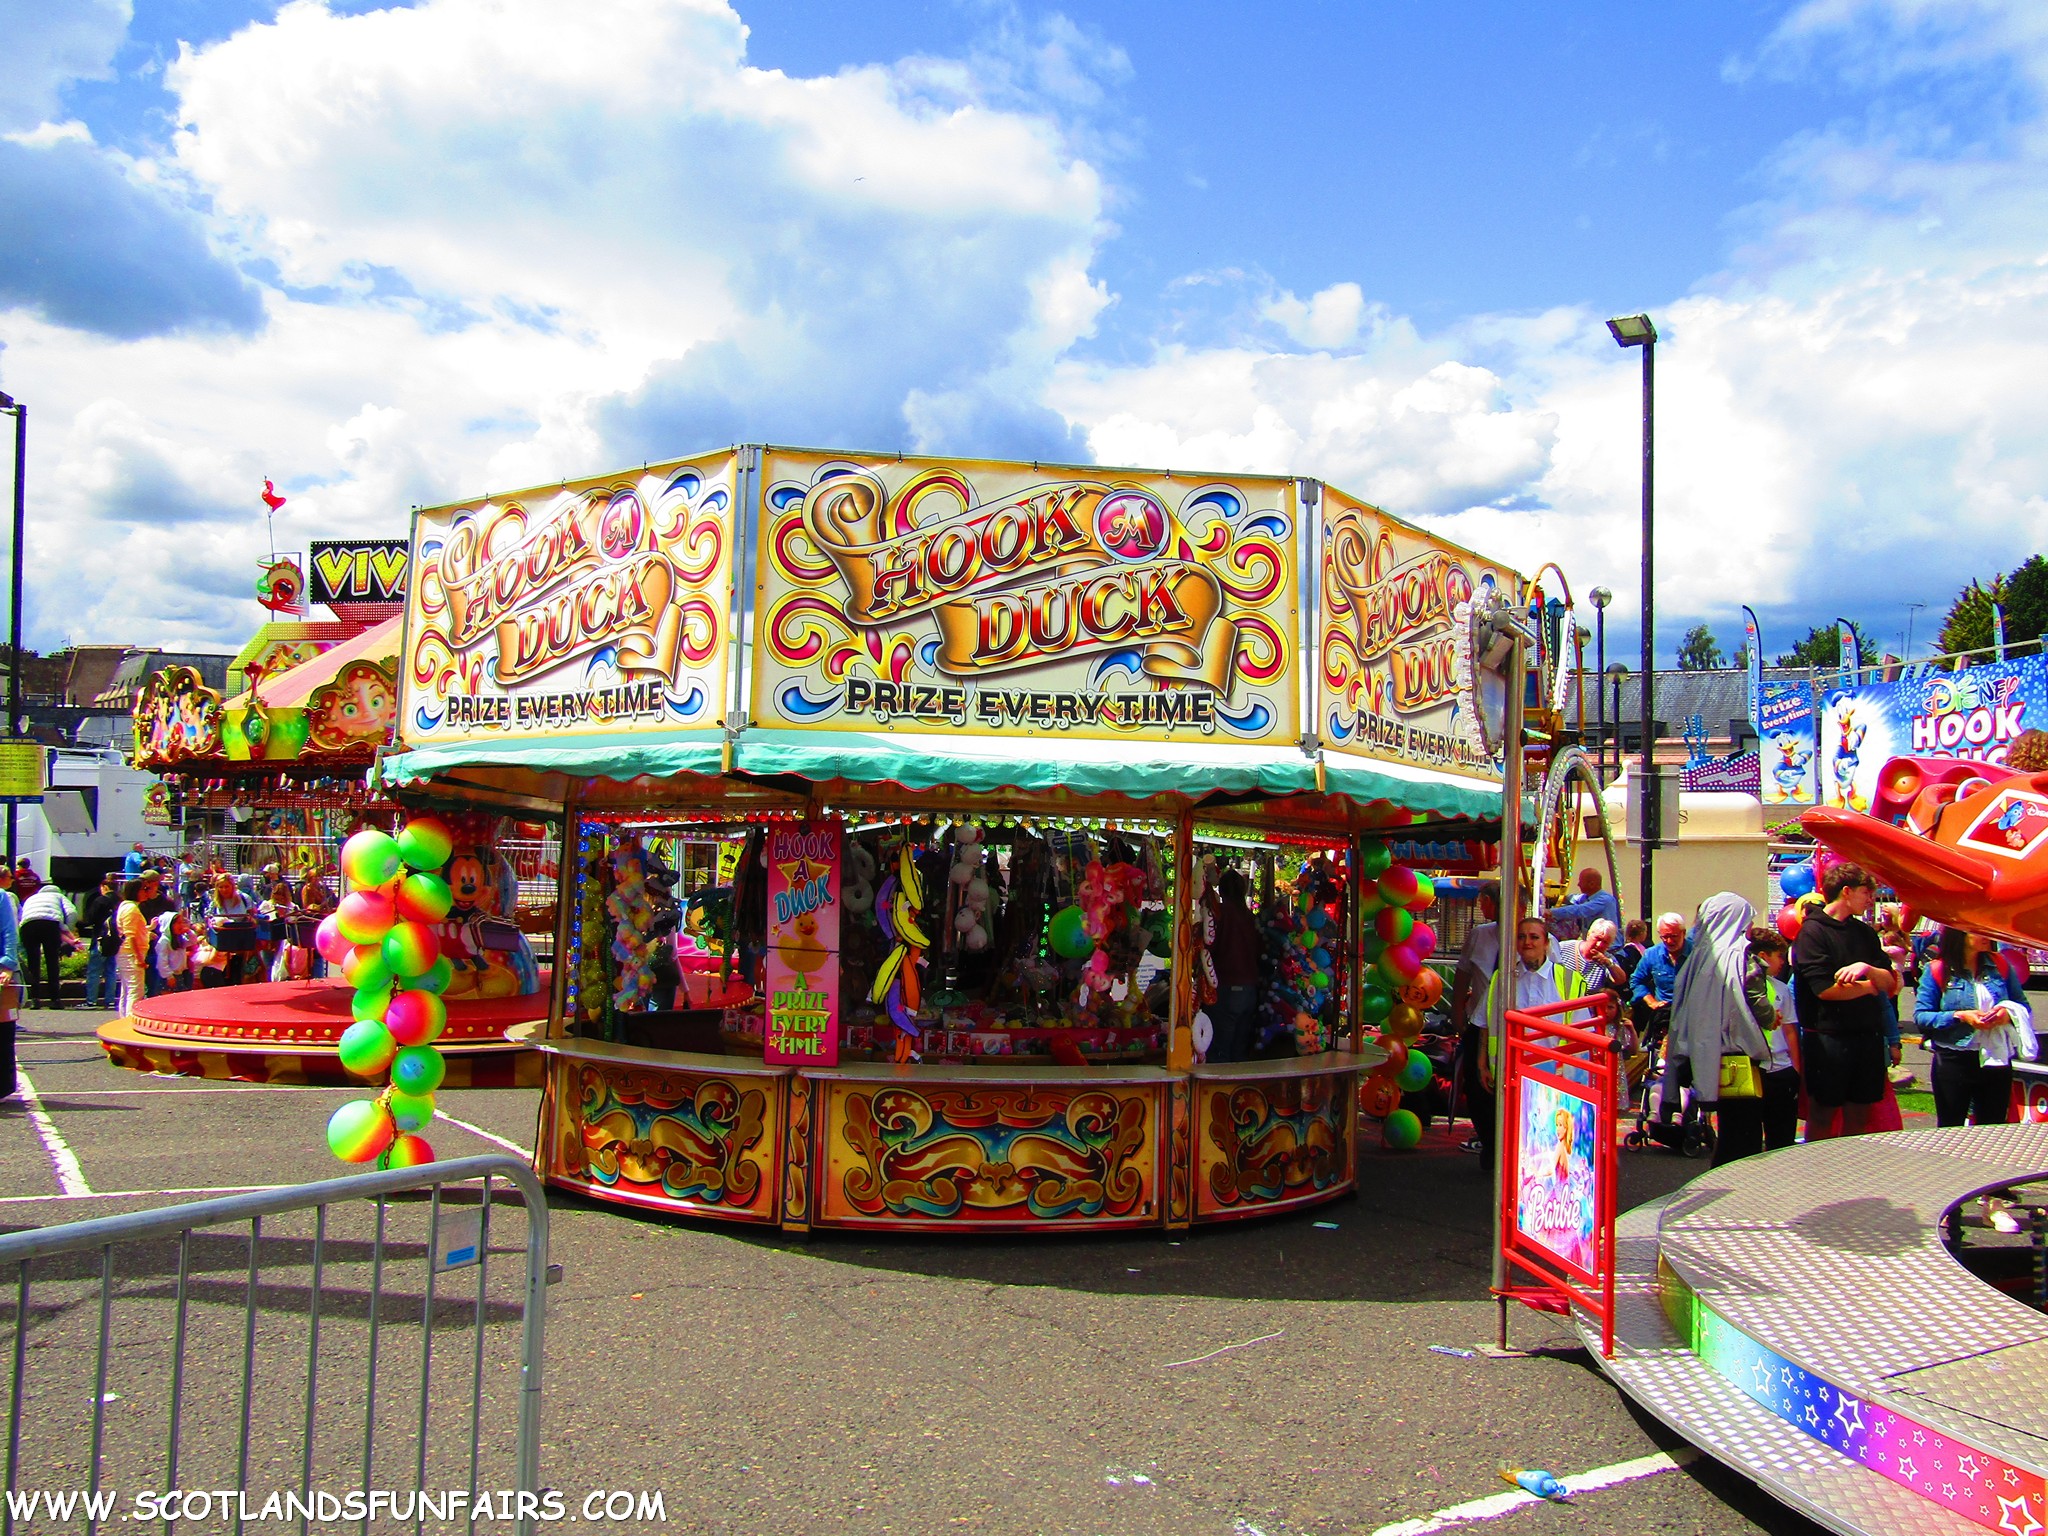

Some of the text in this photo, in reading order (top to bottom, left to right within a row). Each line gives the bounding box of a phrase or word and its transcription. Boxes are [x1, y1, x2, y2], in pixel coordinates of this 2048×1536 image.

[314, 546, 408, 599] VIV
[460, 492, 600, 641] HOOK
[866, 483, 1155, 618] HOOK A
[514, 553, 656, 675] DUCK
[970, 560, 1193, 667] DUCK
[1364, 551, 1444, 656] HOOK
[1401, 637, 1458, 707] DUC
[447, 681, 665, 726] PRIZE EVERY TIME
[845, 678, 1215, 734] PRIZE EVERY TIME
[1761, 697, 1803, 718] Prize
[1761, 707, 1812, 731] Everytime
[1911, 701, 2026, 751] HOOK
[1356, 706, 1404, 755] PRIZE
[1407, 727, 1457, 765] EVERY
[773, 832, 836, 859] HOOK
[792, 859, 809, 881] A
[1389, 839, 1473, 861] WHEEL
[775, 874, 833, 922] DUCK
[773, 992, 828, 1010] PRIZE
[794, 971, 808, 990] A
[772, 1015, 830, 1033] EVERY
[778, 1037, 823, 1055] TIME
[1529, 1183, 1581, 1234] Barbie
